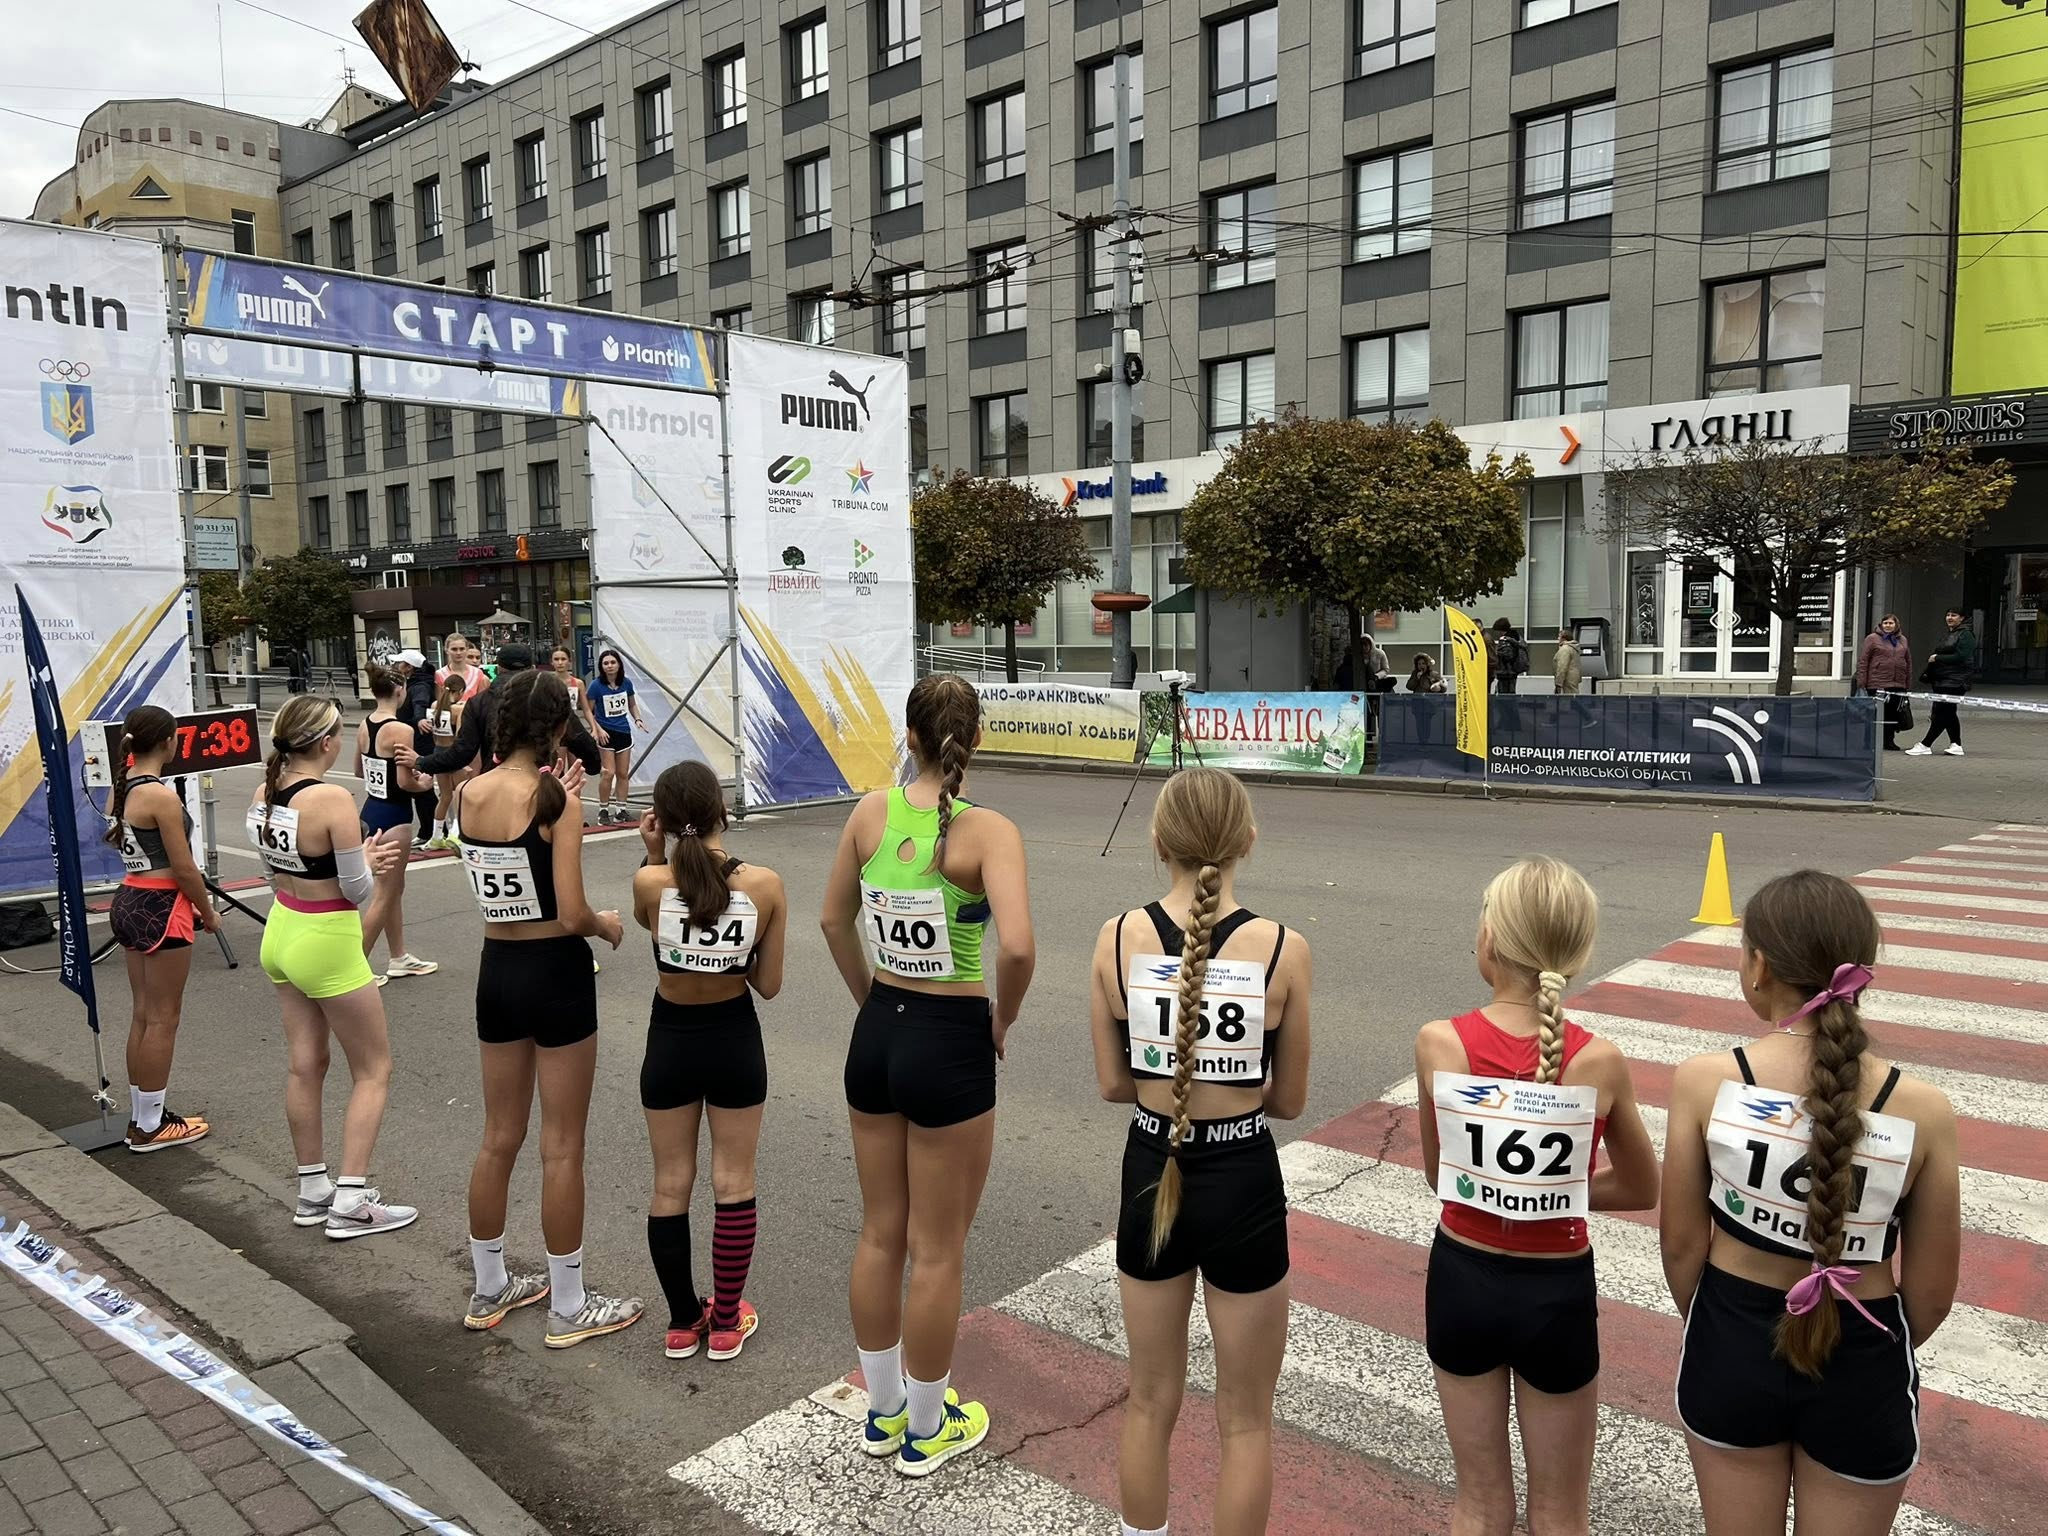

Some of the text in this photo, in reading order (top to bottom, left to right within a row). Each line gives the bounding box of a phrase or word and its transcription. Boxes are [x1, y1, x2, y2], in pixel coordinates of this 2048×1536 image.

[237, 292, 313, 328] PUMA
[393, 302, 569, 360] СТАРТ
[780, 393, 858, 432] PUMA
[1889, 401, 2024, 438] STORIES
[1651, 409, 1792, 450] ҐЛЯНЦ
[1976, 431, 2024, 443] clinic
[768, 488, 814, 498] UKRAINIAN
[768, 497, 802, 506] SPORTS
[768, 505, 797, 514] CLINIC
[832, 498, 889, 512] TRIBUNA.COM
[767, 571, 822, 593] ДЕВАЙТІС
[848, 571, 878, 586] PRONTO
[856, 585, 872, 596] PIZZA
[609, 699, 626, 709] 139
[989, 720, 1072, 737] СПОРТИВНОЇ
[1079, 725, 1136, 742] ХОДЬБИ
[1491, 746, 1691, 764] ФЕДЕРАЦІЯ ЛЕГКОЇ АТЛЕТИКИ
[366, 769, 384, 786] 153
[1490, 763, 1692, 782] ІВАНО-ФРАНКІВСЬКОЇ ОБЛАСТІ
[256, 824, 290, 852] 163
[471, 870, 523, 898] 155
[873, 914, 936, 950] 140
[1514, 1090, 1556, 1100] ФЕДЕРАЦІЯ
[1514, 1098, 1580, 1109] ЛЕГКОЇ АТЛЕТИКИ
[1513, 1105, 1546, 1115] УКРАЇНИ
[1134, 1106, 1160, 1135] PRO
[1206, 1117, 1253, 1143] NIKE
[1465, 1122, 1573, 1176] 162
